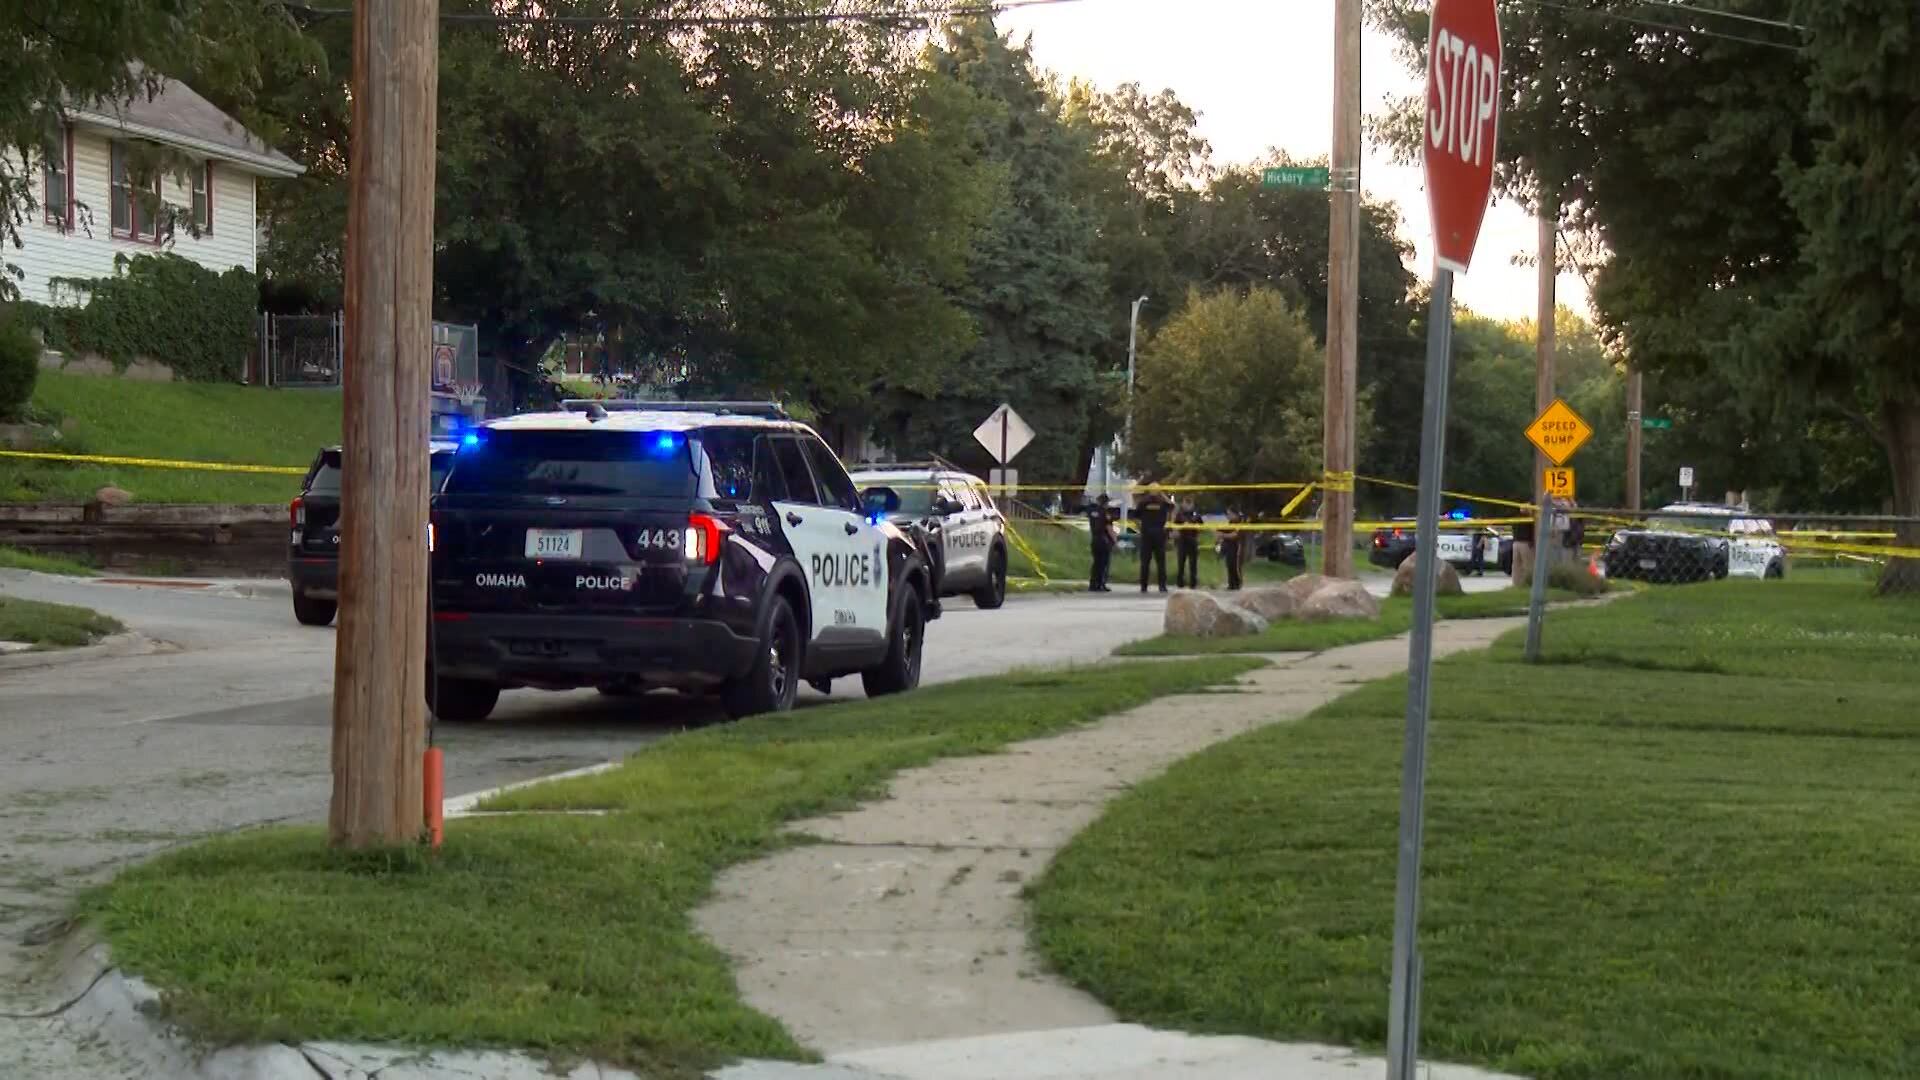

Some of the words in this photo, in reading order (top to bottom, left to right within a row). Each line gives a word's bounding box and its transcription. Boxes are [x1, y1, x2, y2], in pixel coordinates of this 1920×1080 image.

[1430, 28, 1494, 167] STOP
[1267, 171, 1304, 186] Hickory
[1541, 421, 1576, 431] SPEED
[1544, 435, 1574, 444] BUMP
[1552, 471, 1568, 488] 15
[538, 536, 569, 552] 51124
[637, 529, 680, 549] 443
[952, 531, 986, 548] POLICE
[811, 553, 869, 588] POLICE
[475, 573, 526, 587] OMAHA
[575, 576, 631, 589] POLICE
